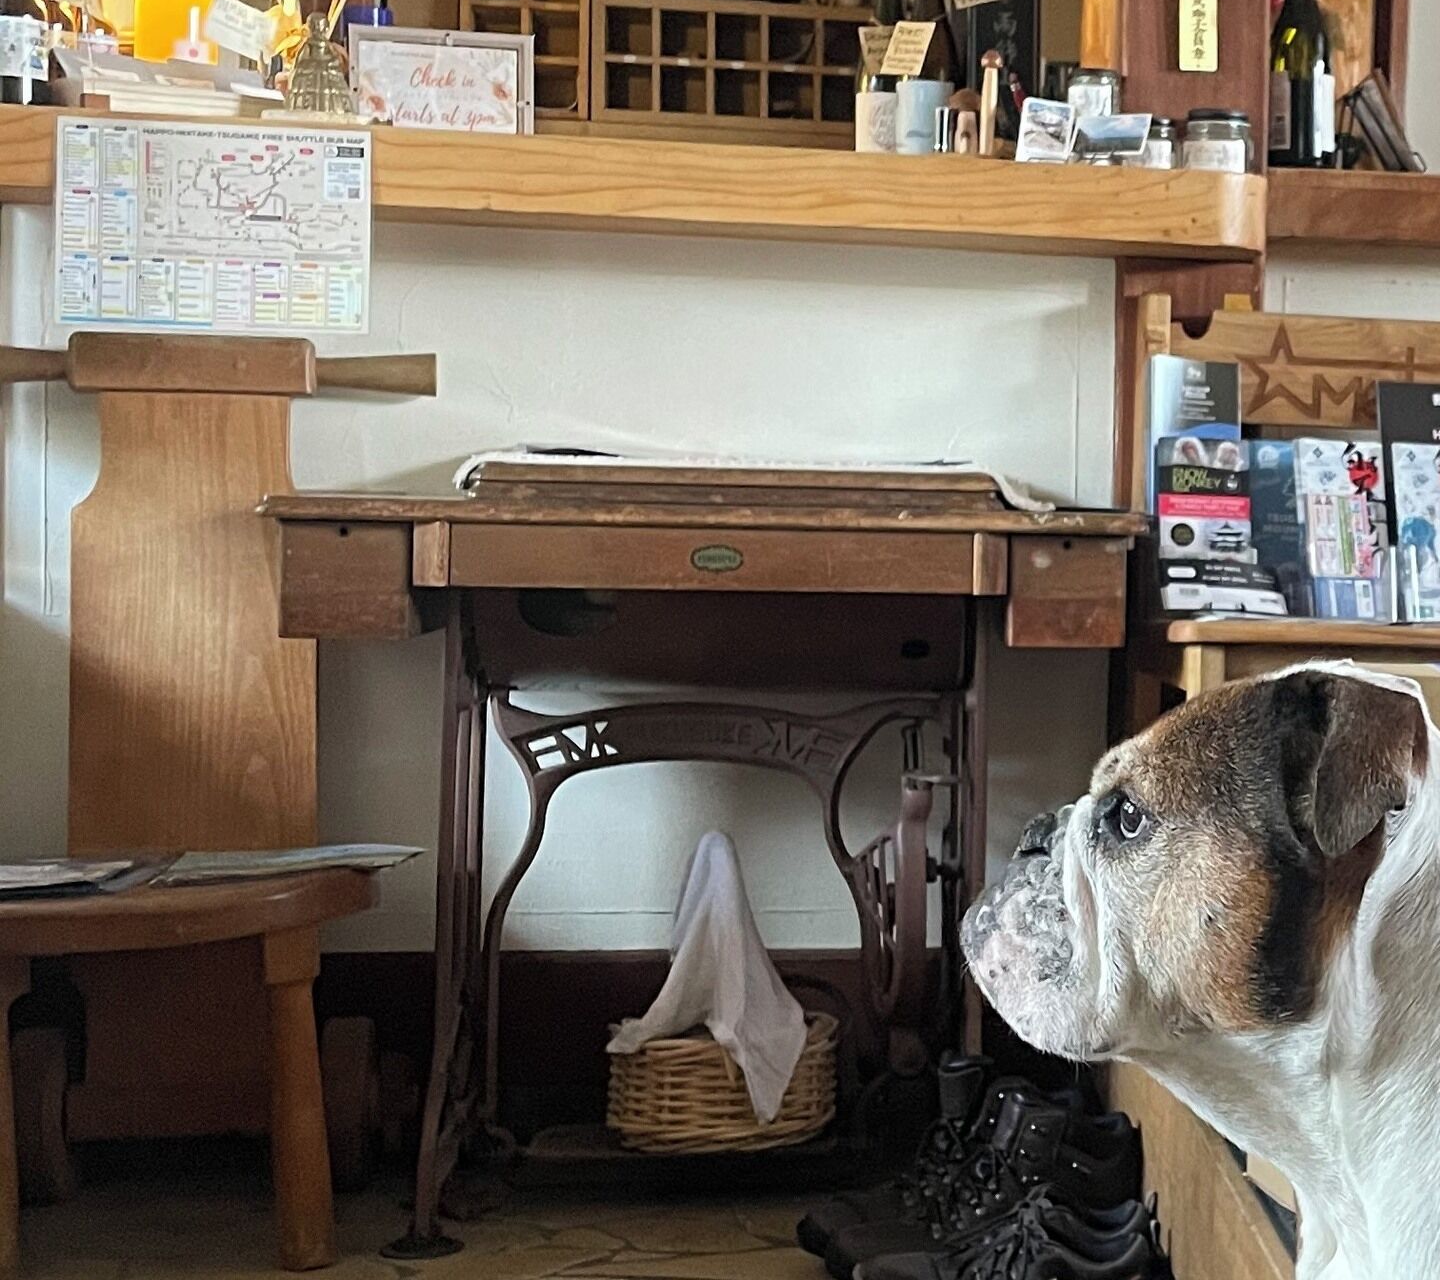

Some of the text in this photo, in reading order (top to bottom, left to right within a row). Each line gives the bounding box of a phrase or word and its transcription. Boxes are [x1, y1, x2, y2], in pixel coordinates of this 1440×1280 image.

[409, 64, 476, 89] Check in
[440, 104, 460, 127] at
[464, 111, 498, 131] 3pm
